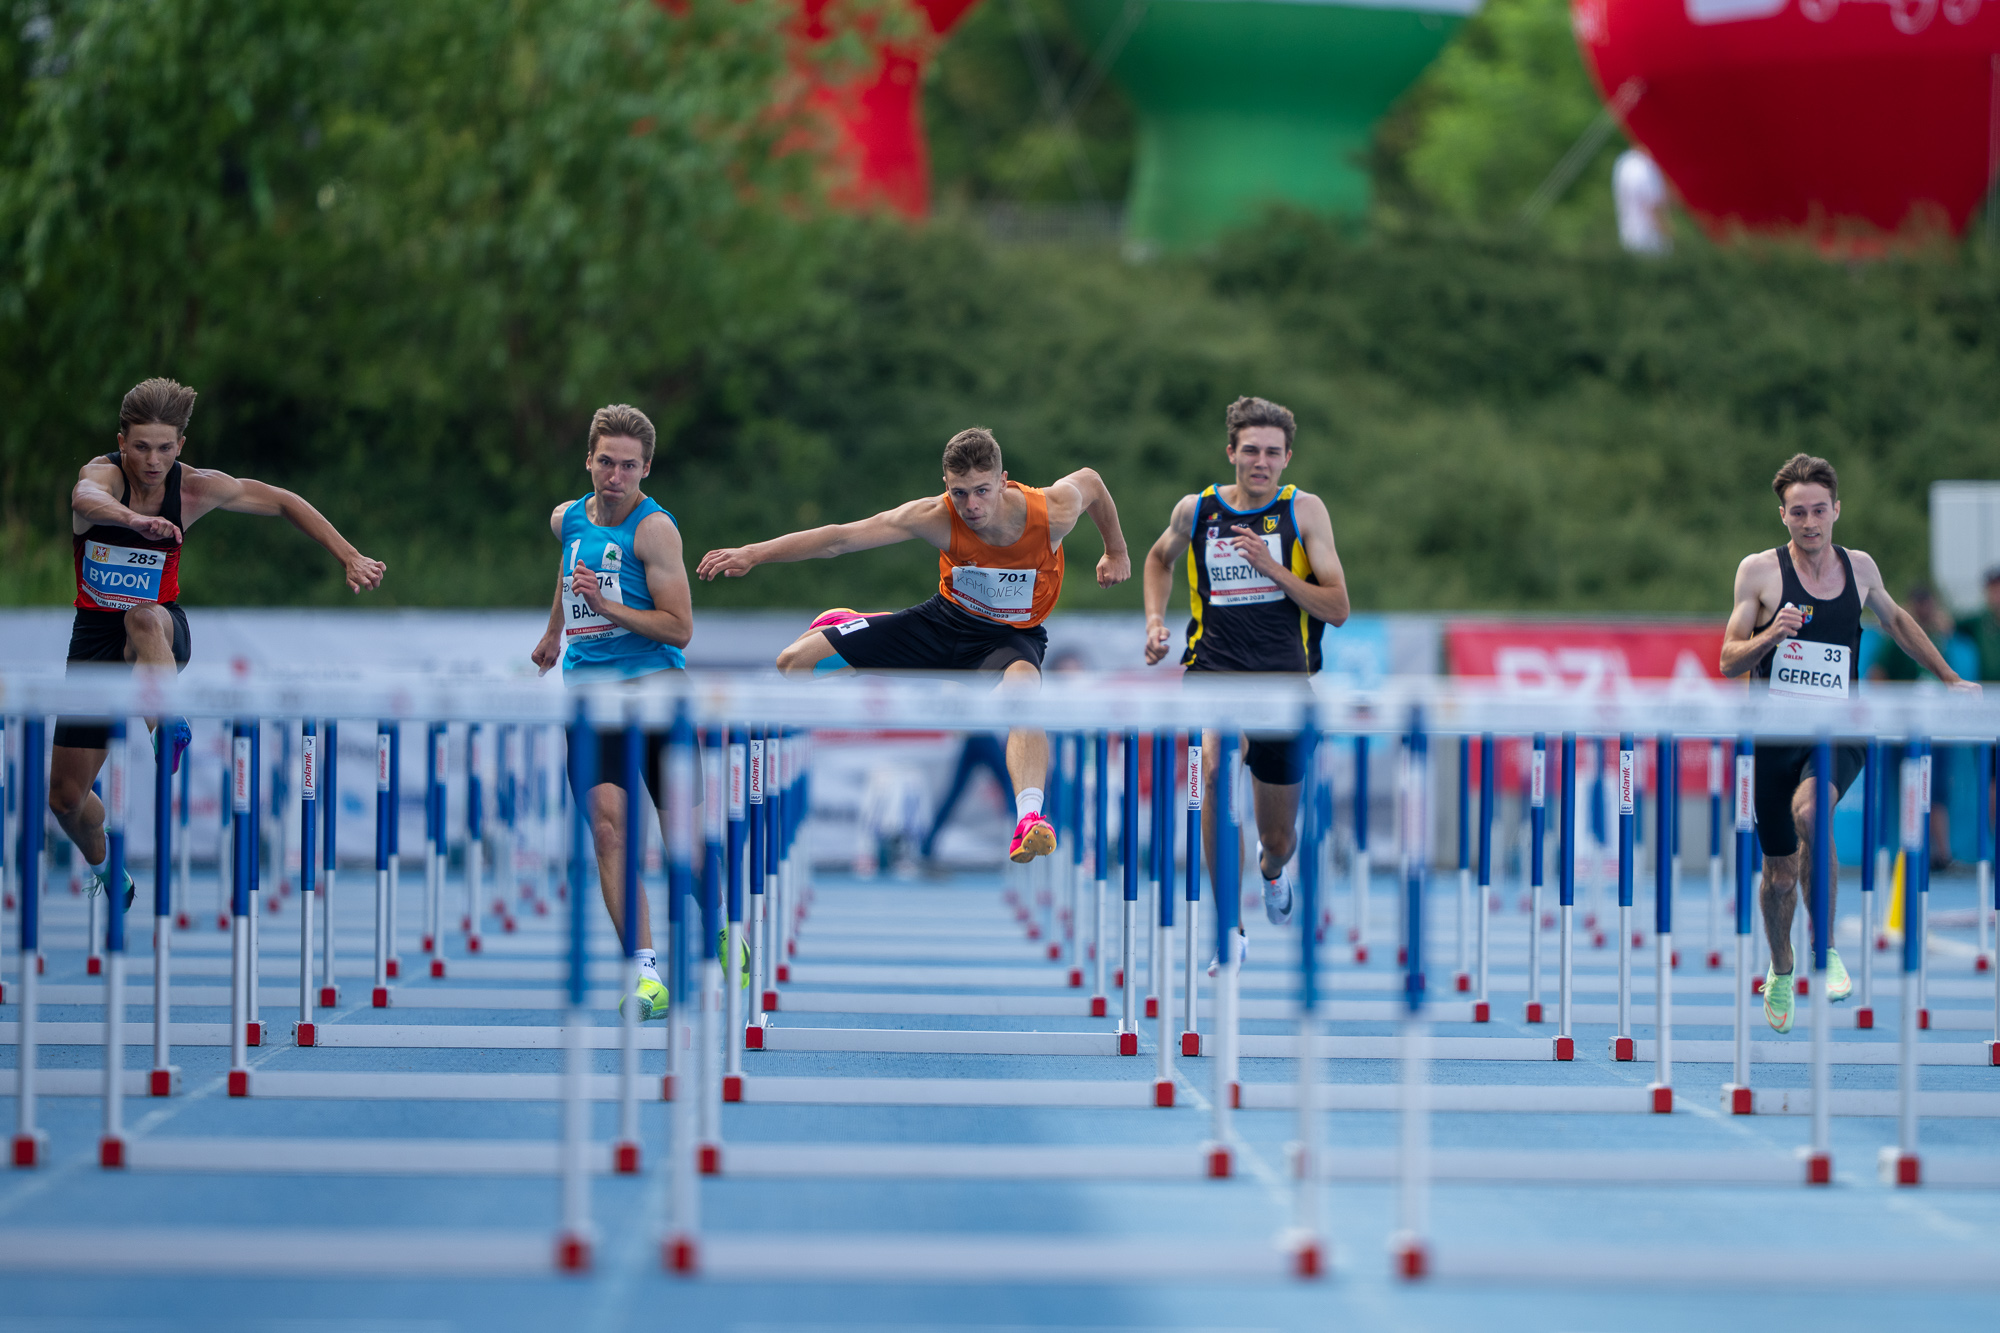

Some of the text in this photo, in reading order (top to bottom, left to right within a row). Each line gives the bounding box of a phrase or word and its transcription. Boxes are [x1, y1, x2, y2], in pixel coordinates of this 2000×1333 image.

[127, 552, 158, 566] 285
[570, 538, 581, 570] 1
[89, 566, 151, 590] BYDOŃ
[956, 574, 1024, 599] KAMIONEK
[998, 572, 1028, 583] 701
[95, 597, 117, 608] LUBLIN
[969, 604, 992, 616] LUBLIN
[1783, 653, 1803, 661] ORLEN
[1823, 648, 1842, 663] 33
[1778, 667, 1843, 690] GEREGA
[304, 751, 313, 788] polanik
[752, 757, 761, 792] polanik
[1189, 762, 1199, 799] polanik
[1622, 766, 1632, 803] polanik
